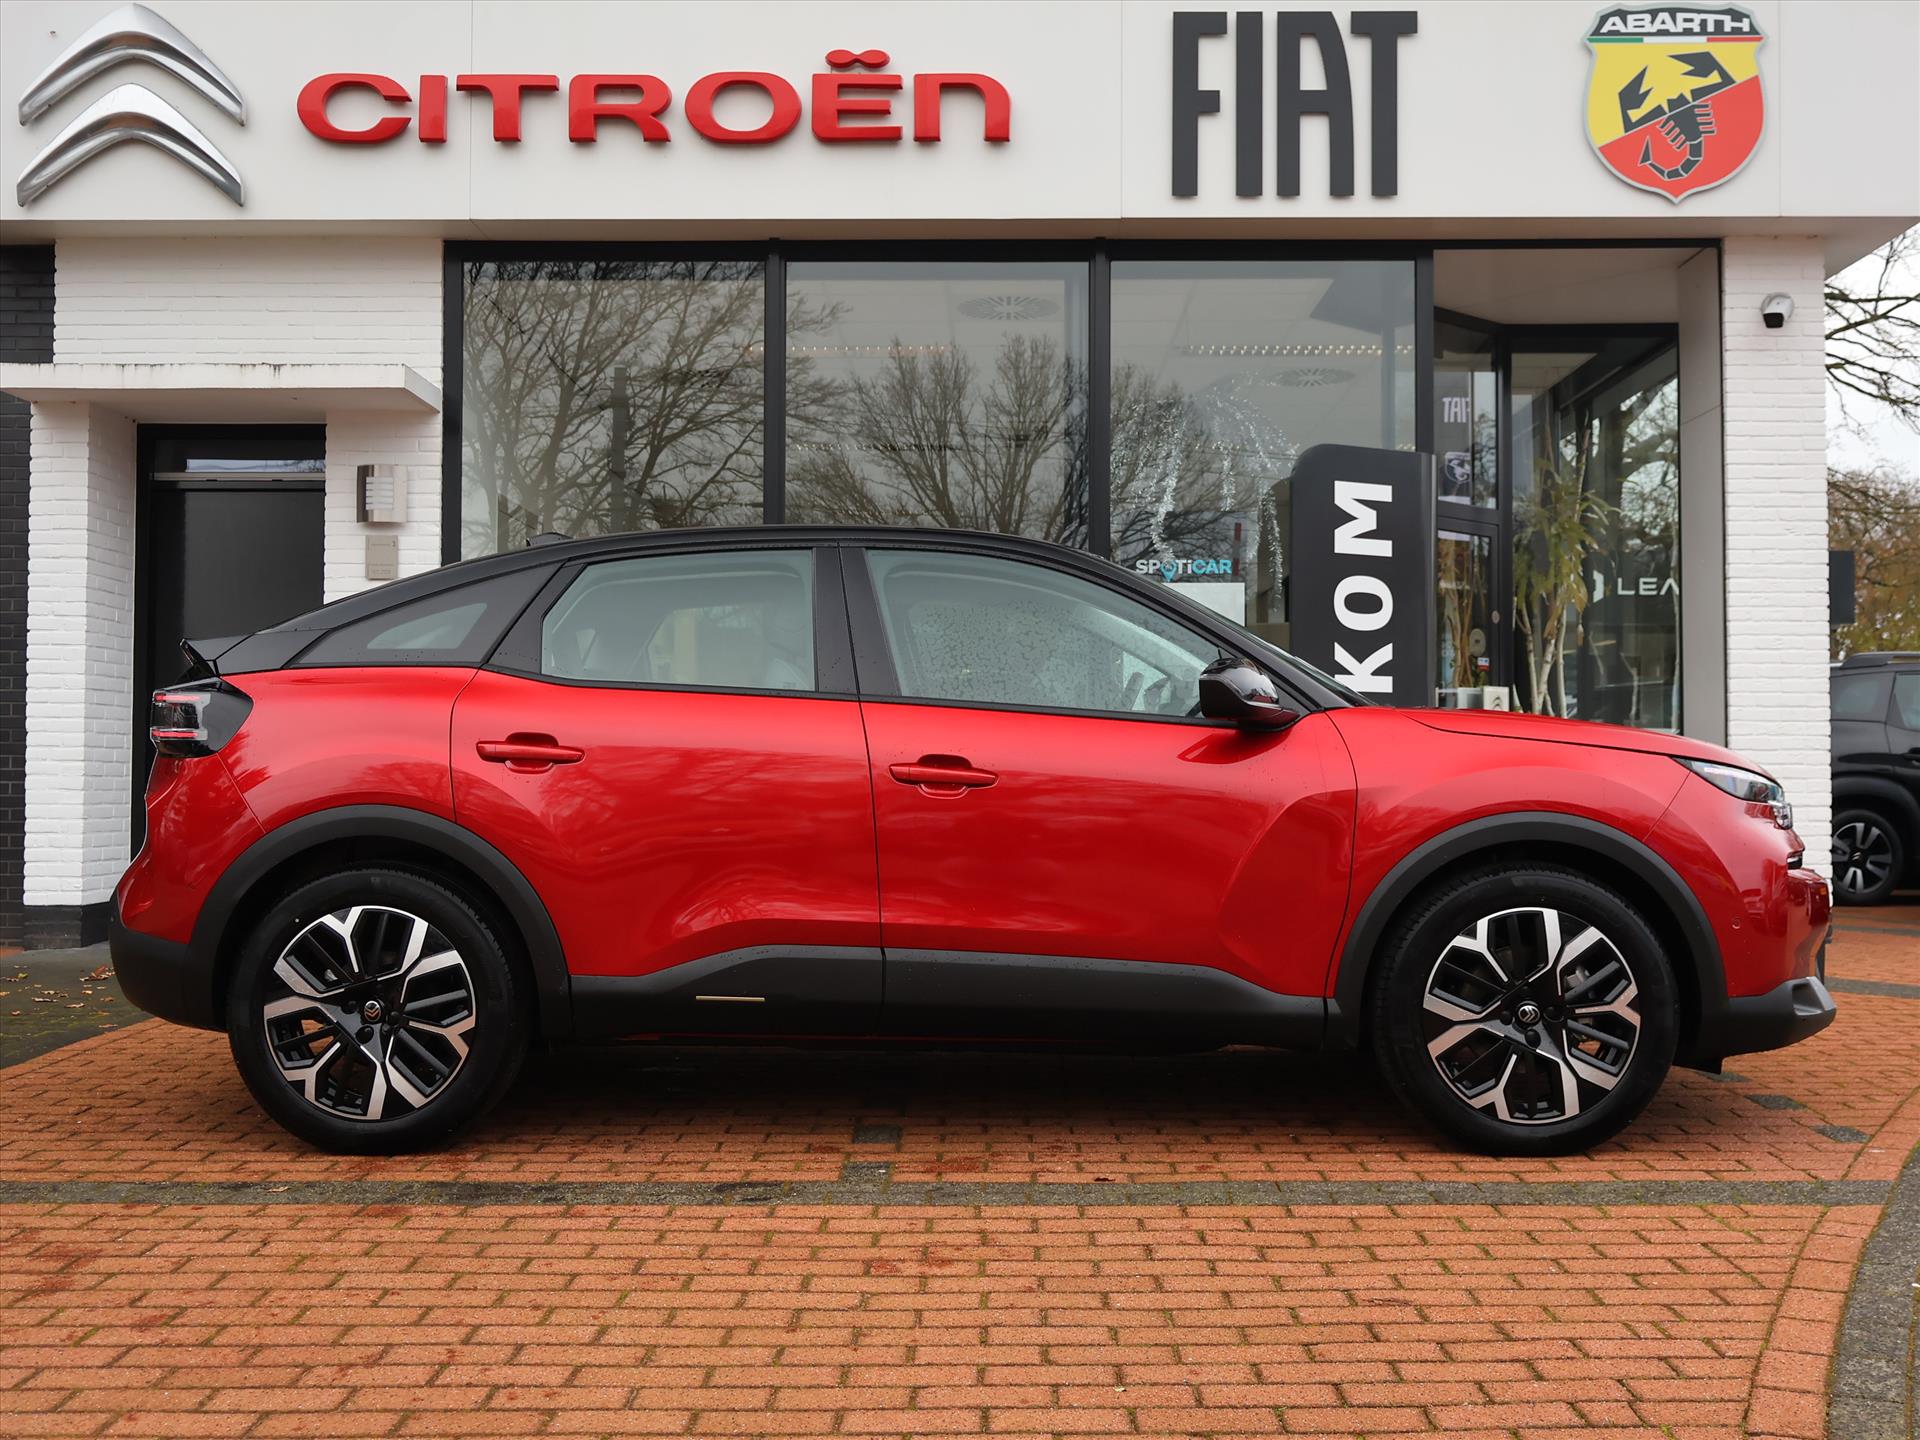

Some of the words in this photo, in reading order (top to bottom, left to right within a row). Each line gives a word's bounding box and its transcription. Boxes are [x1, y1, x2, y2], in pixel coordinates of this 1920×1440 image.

[1172, 11, 1418, 196] FIAT
[1600, 12, 1750, 33] ABARTH
[1333, 480, 1394, 694] KOM
